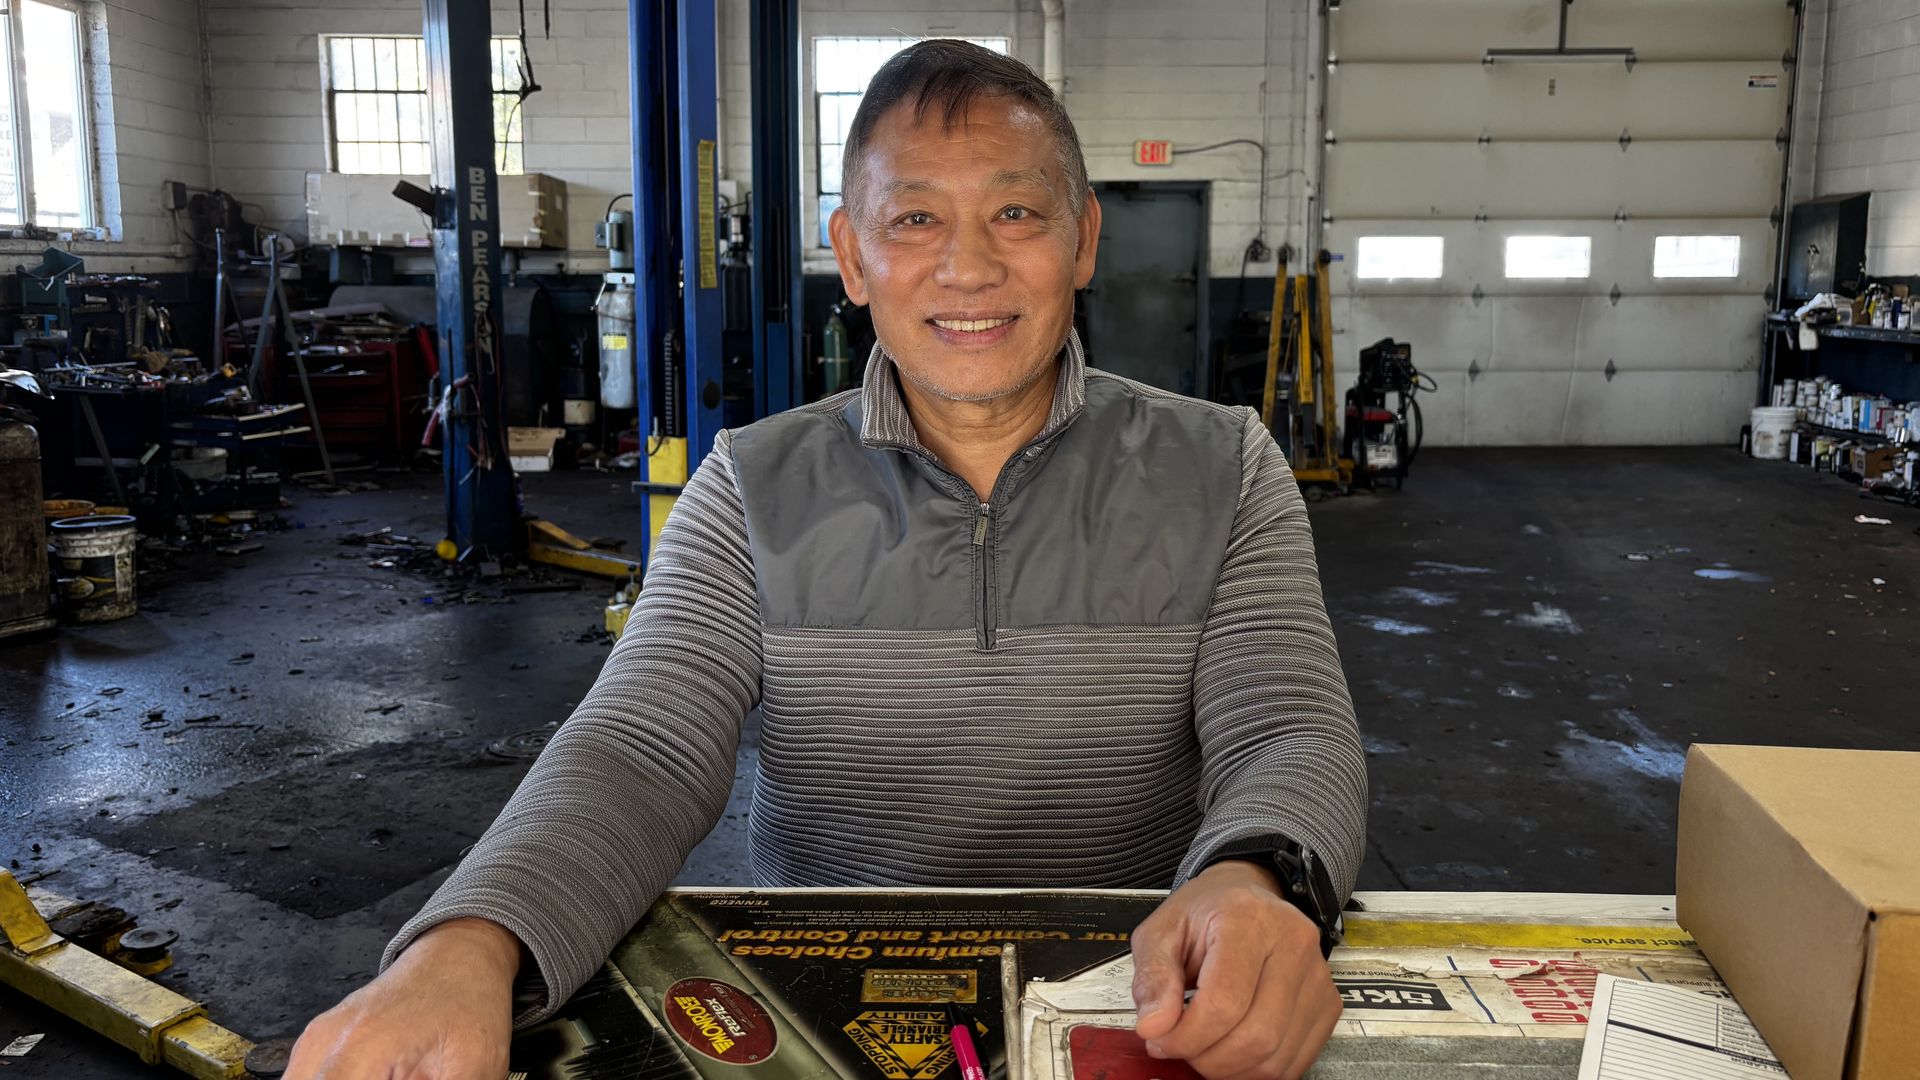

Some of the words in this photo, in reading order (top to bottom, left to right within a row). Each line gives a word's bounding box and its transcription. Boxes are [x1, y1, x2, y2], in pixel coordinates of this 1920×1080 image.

[1140, 142, 1168, 162] EXIT
[469, 166, 488, 221] BEN
[714, 930, 848, 944] Control
[854, 930, 924, 944] and
[1575, 938, 1646, 947] service.
[729, 945, 873, 960] Choices
[882, 945, 1003, 958] emium
[882, 990, 956, 998] SAFE
[1341, 990, 1434, 1005] SKF
[703, 997, 748, 1036] Reflex
[674, 996, 734, 1054] MONROE
[881, 1025, 950, 1034] TRIANGLE
[888, 1034, 943, 1044] SAFETY
[848, 1028, 900, 1074] STOPPING
